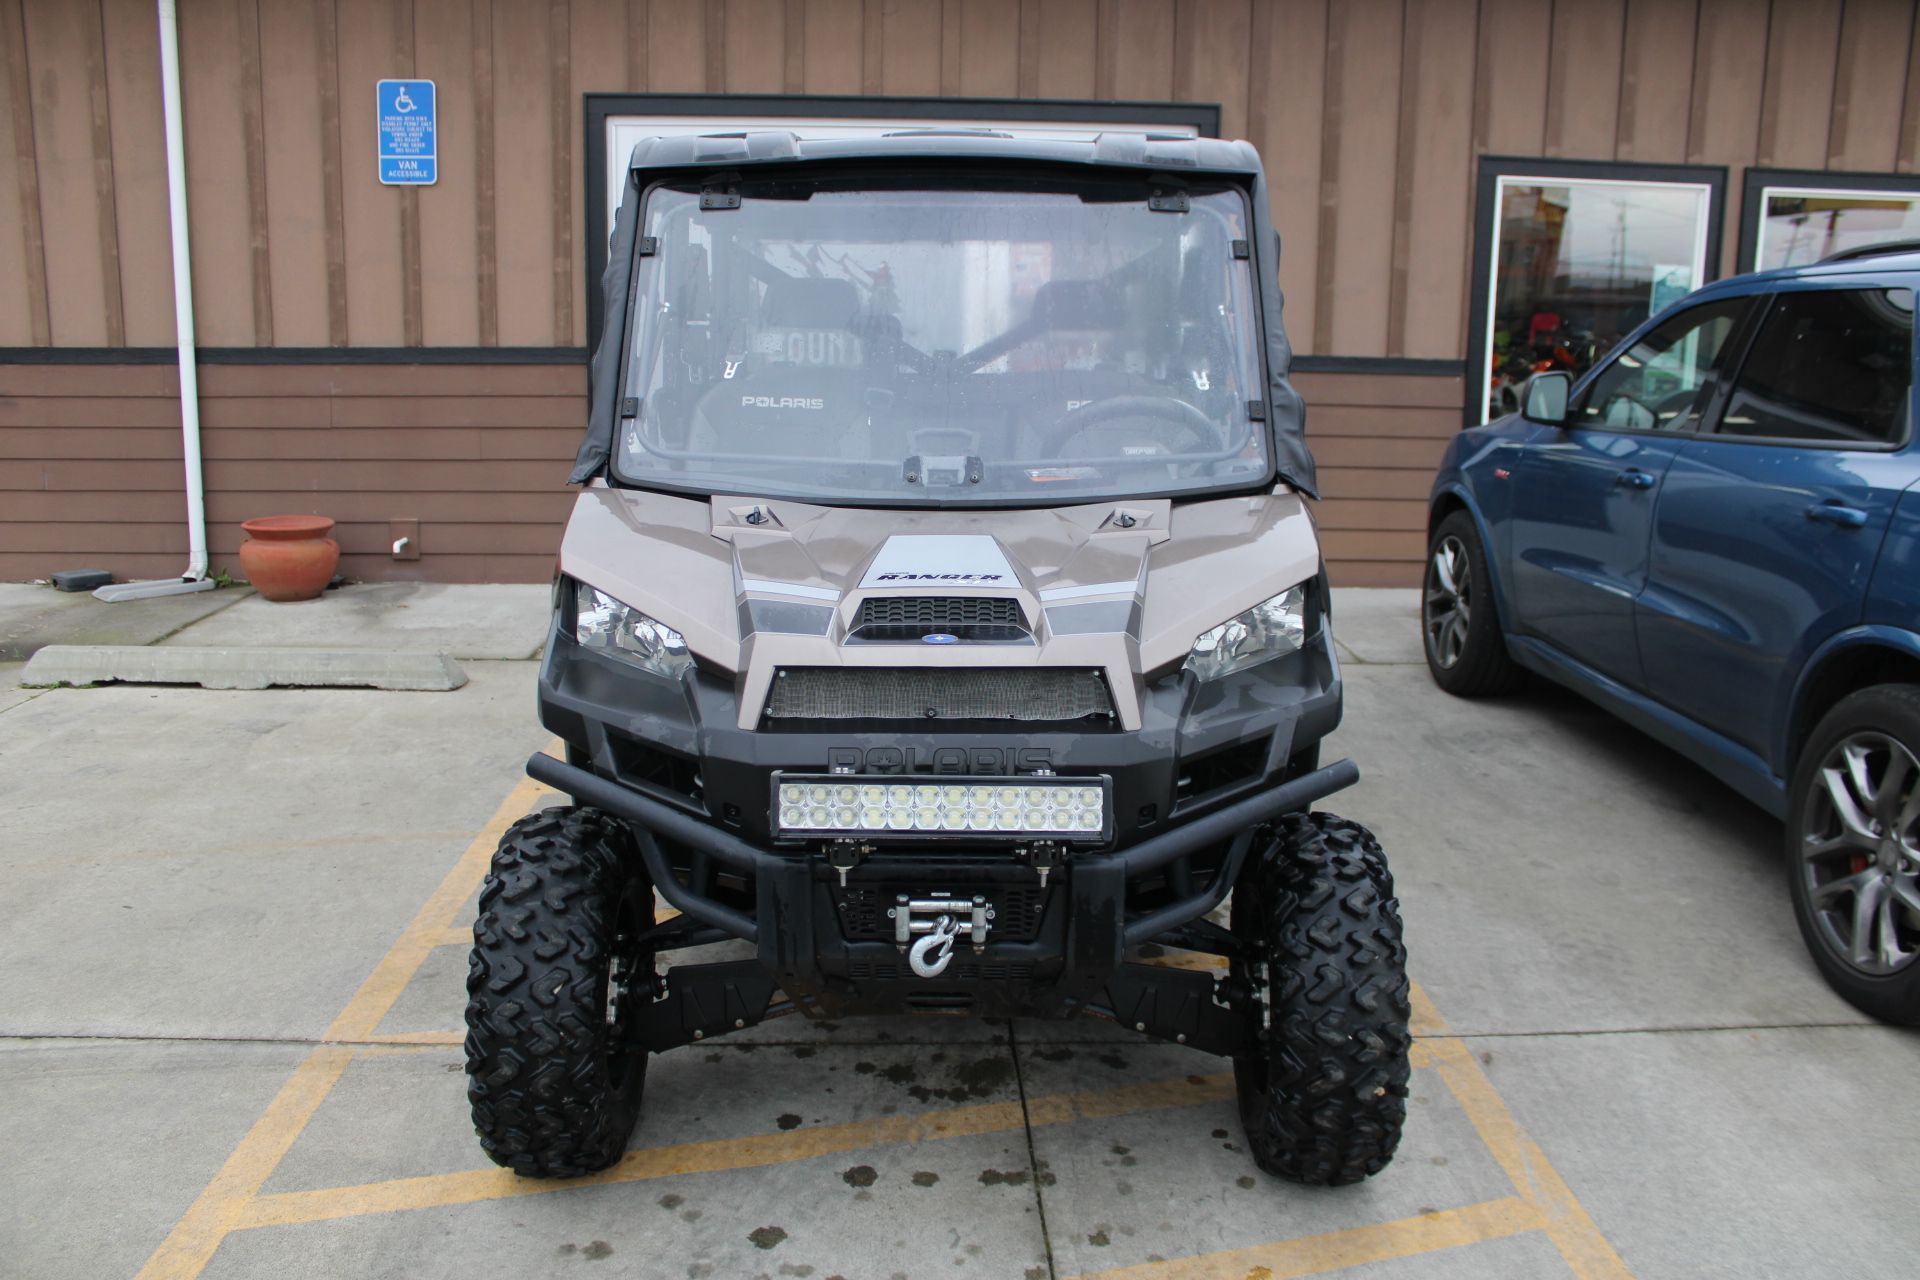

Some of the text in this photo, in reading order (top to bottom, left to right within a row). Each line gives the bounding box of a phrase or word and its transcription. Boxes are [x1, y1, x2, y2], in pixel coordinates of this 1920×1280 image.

[398, 160, 418, 170] VAN
[742, 396, 824, 409] POLARIS
[828, 747, 1055, 776] POLARIS
